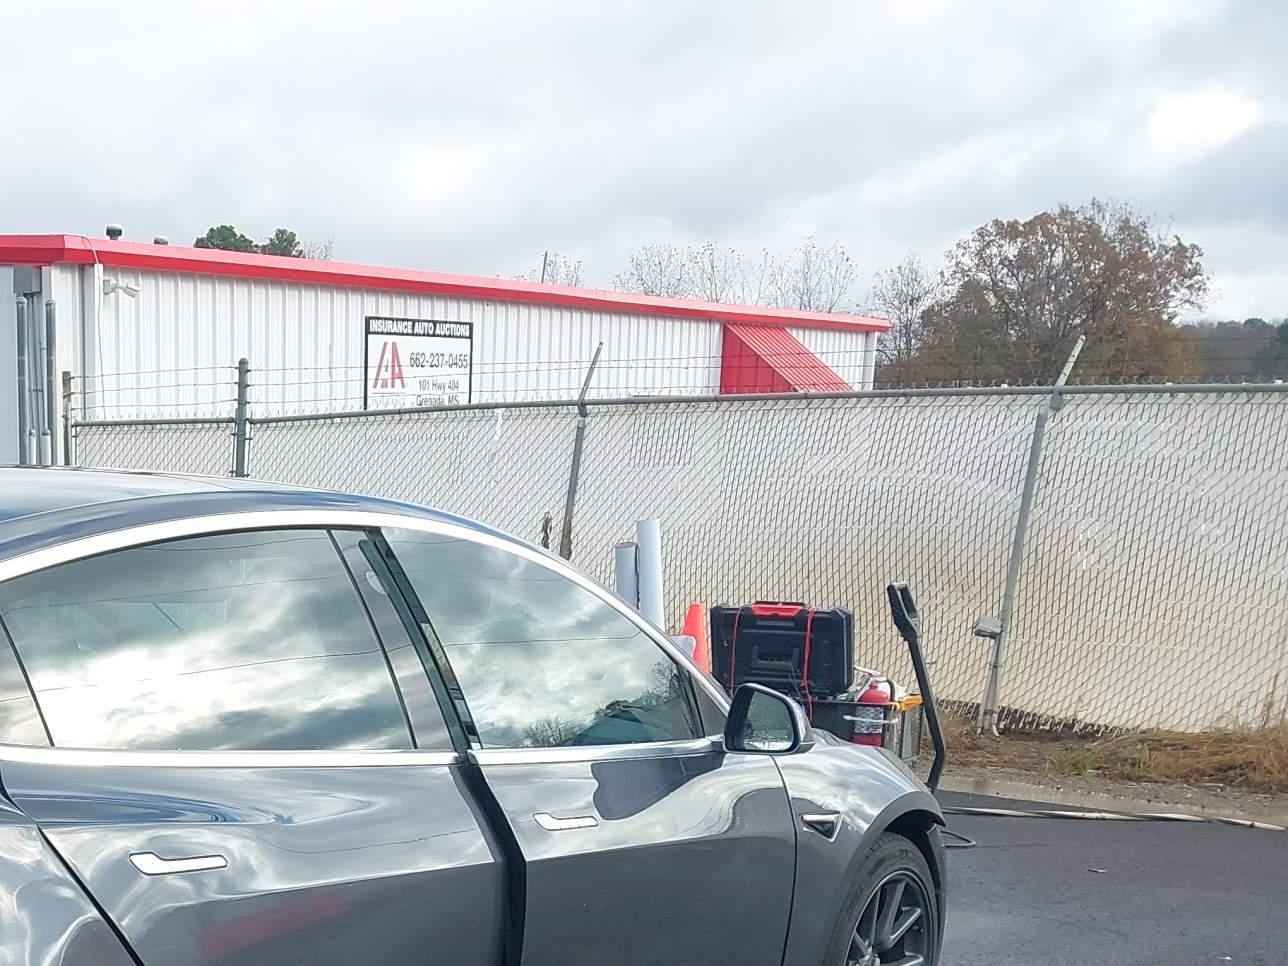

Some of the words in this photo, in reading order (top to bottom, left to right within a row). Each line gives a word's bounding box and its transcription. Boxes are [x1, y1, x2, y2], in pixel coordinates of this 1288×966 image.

[369, 319, 413, 334] INSURANCE
[414, 322, 434, 335] AUTO
[435, 324, 470, 338] AUCTIONS
[409, 352, 468, 369] 662-237-0455
[431, 379, 447, 394] Hwy
